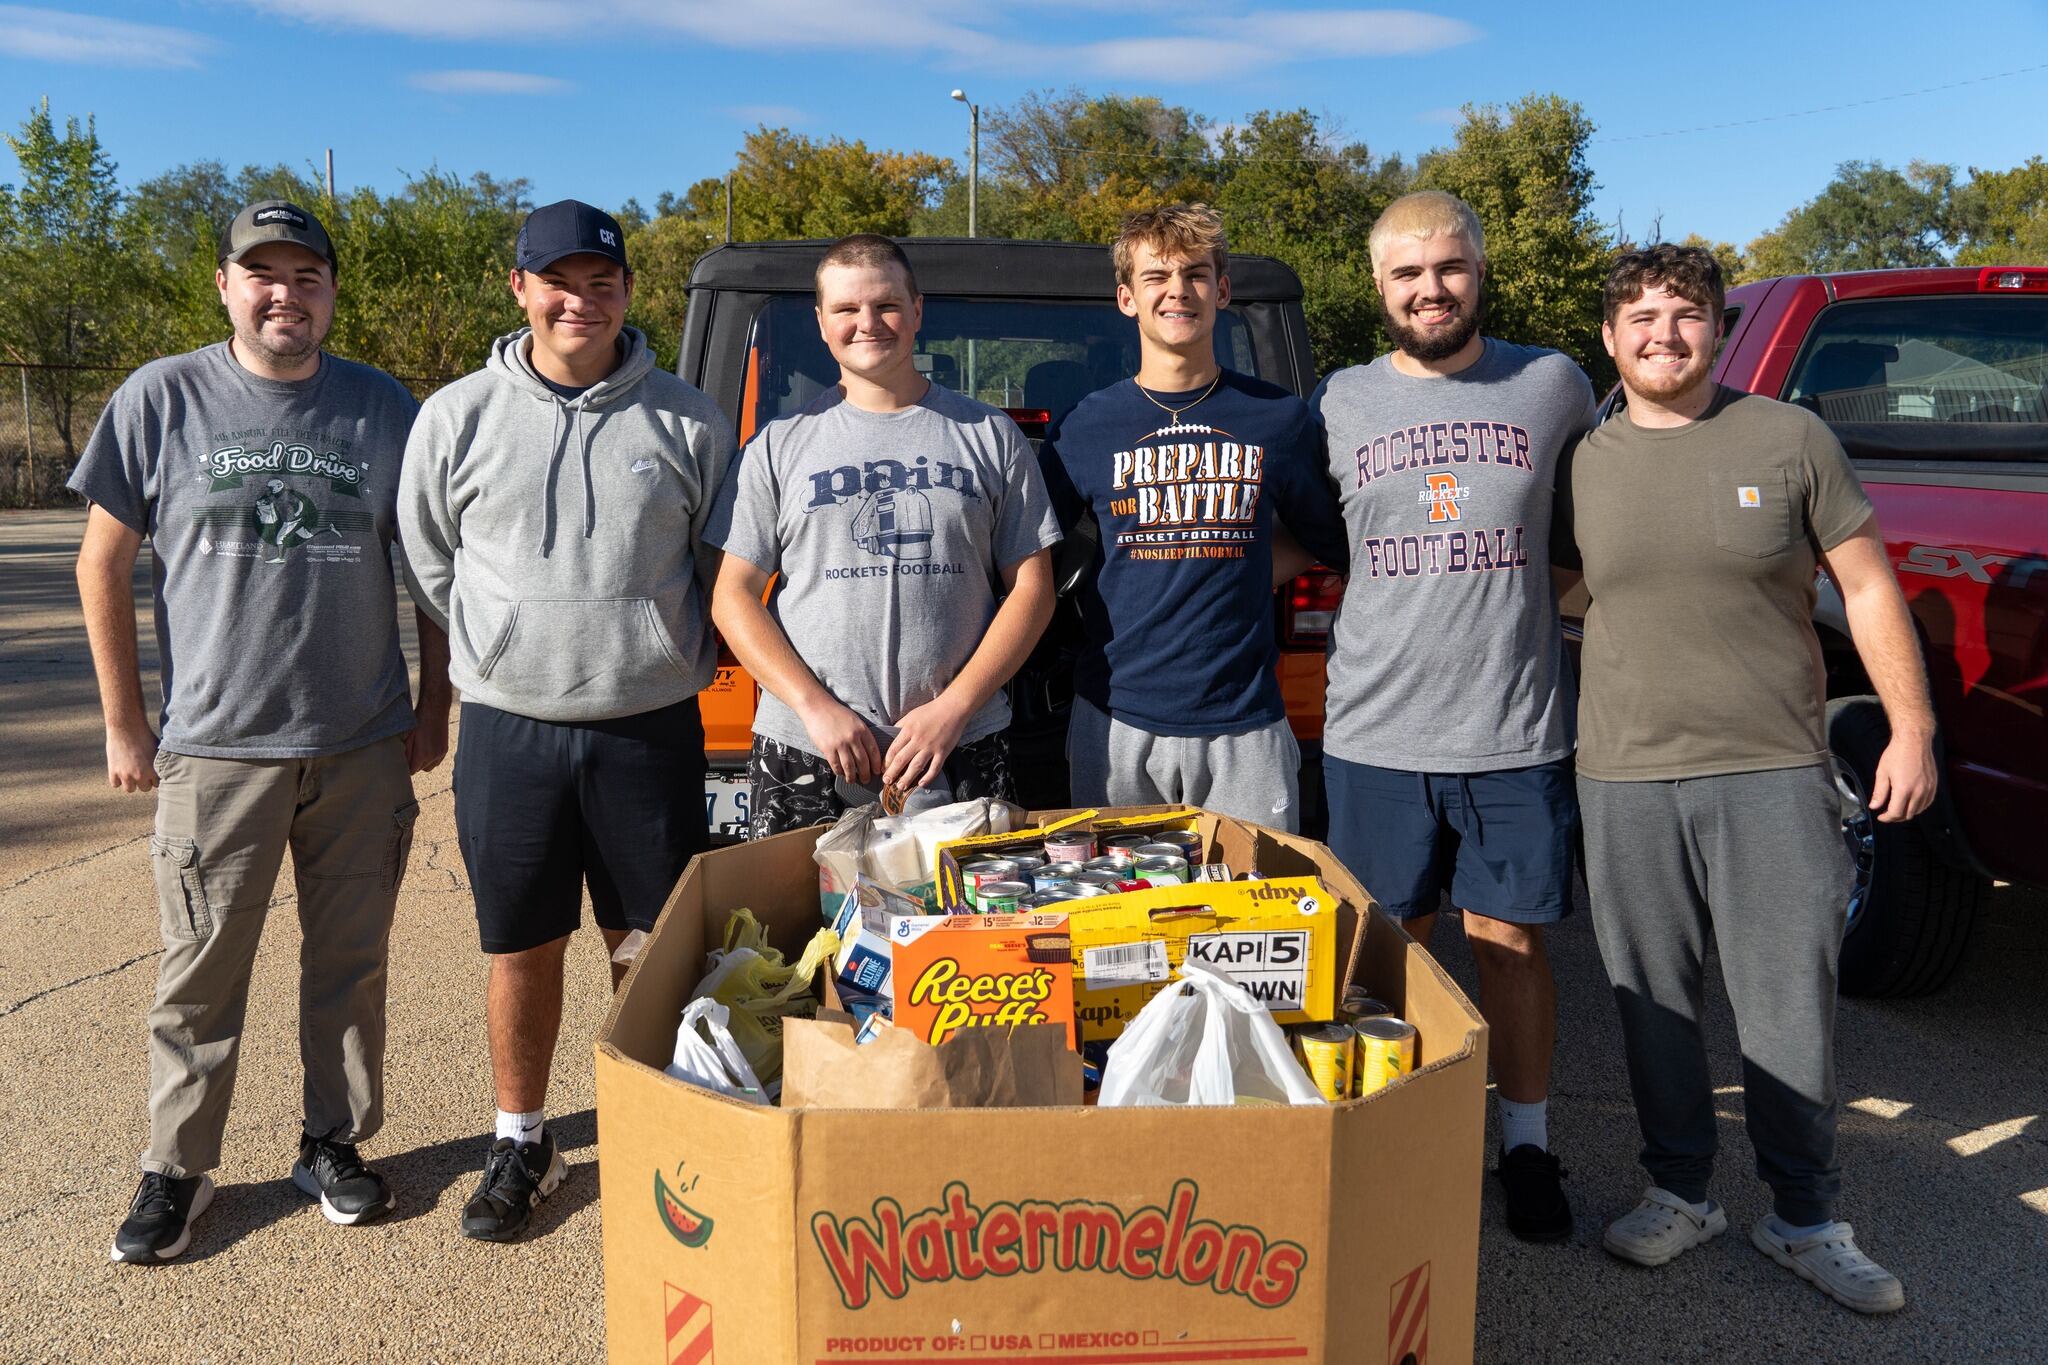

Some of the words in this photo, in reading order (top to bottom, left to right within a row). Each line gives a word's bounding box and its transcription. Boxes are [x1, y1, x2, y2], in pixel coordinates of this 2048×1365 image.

[231, 428, 267, 441] ANNUAL
[296, 430, 312, 440] THE
[211, 440, 286, 478] Food
[286, 443, 360, 484] Drive
[1113, 442, 1263, 491] PREPARE
[1355, 421, 1534, 491] ROCHESTER
[808, 455, 982, 508] pain
[1417, 486, 1470, 502] ROCKETS
[1110, 497, 1137, 517] FOR
[1138, 482, 1261, 527] BATTLE
[1117, 532, 1175, 544] ROCKET
[1181, 530, 1255, 541] FOOTBALL
[1129, 546, 1245, 561] #NOSLEEPTILNORMAL
[1365, 525, 1528, 578] FOOTBALL
[826, 565, 888, 580] ROCKETS
[892, 563, 965, 577] FOOTBALL
[1193, 941, 1263, 963] KAPI
[1270, 936, 1300, 964] 5
[858, 957, 881, 988] SALTINE
[909, 956, 1056, 1007] Reese's
[812, 1179, 1308, 1310] Watermelons
[826, 1335, 925, 1353] PRODUCT
[931, 1335, 967, 1352] OF:
[990, 1334, 1033, 1351] USA
[1058, 1331, 1139, 1349] MEXICO
